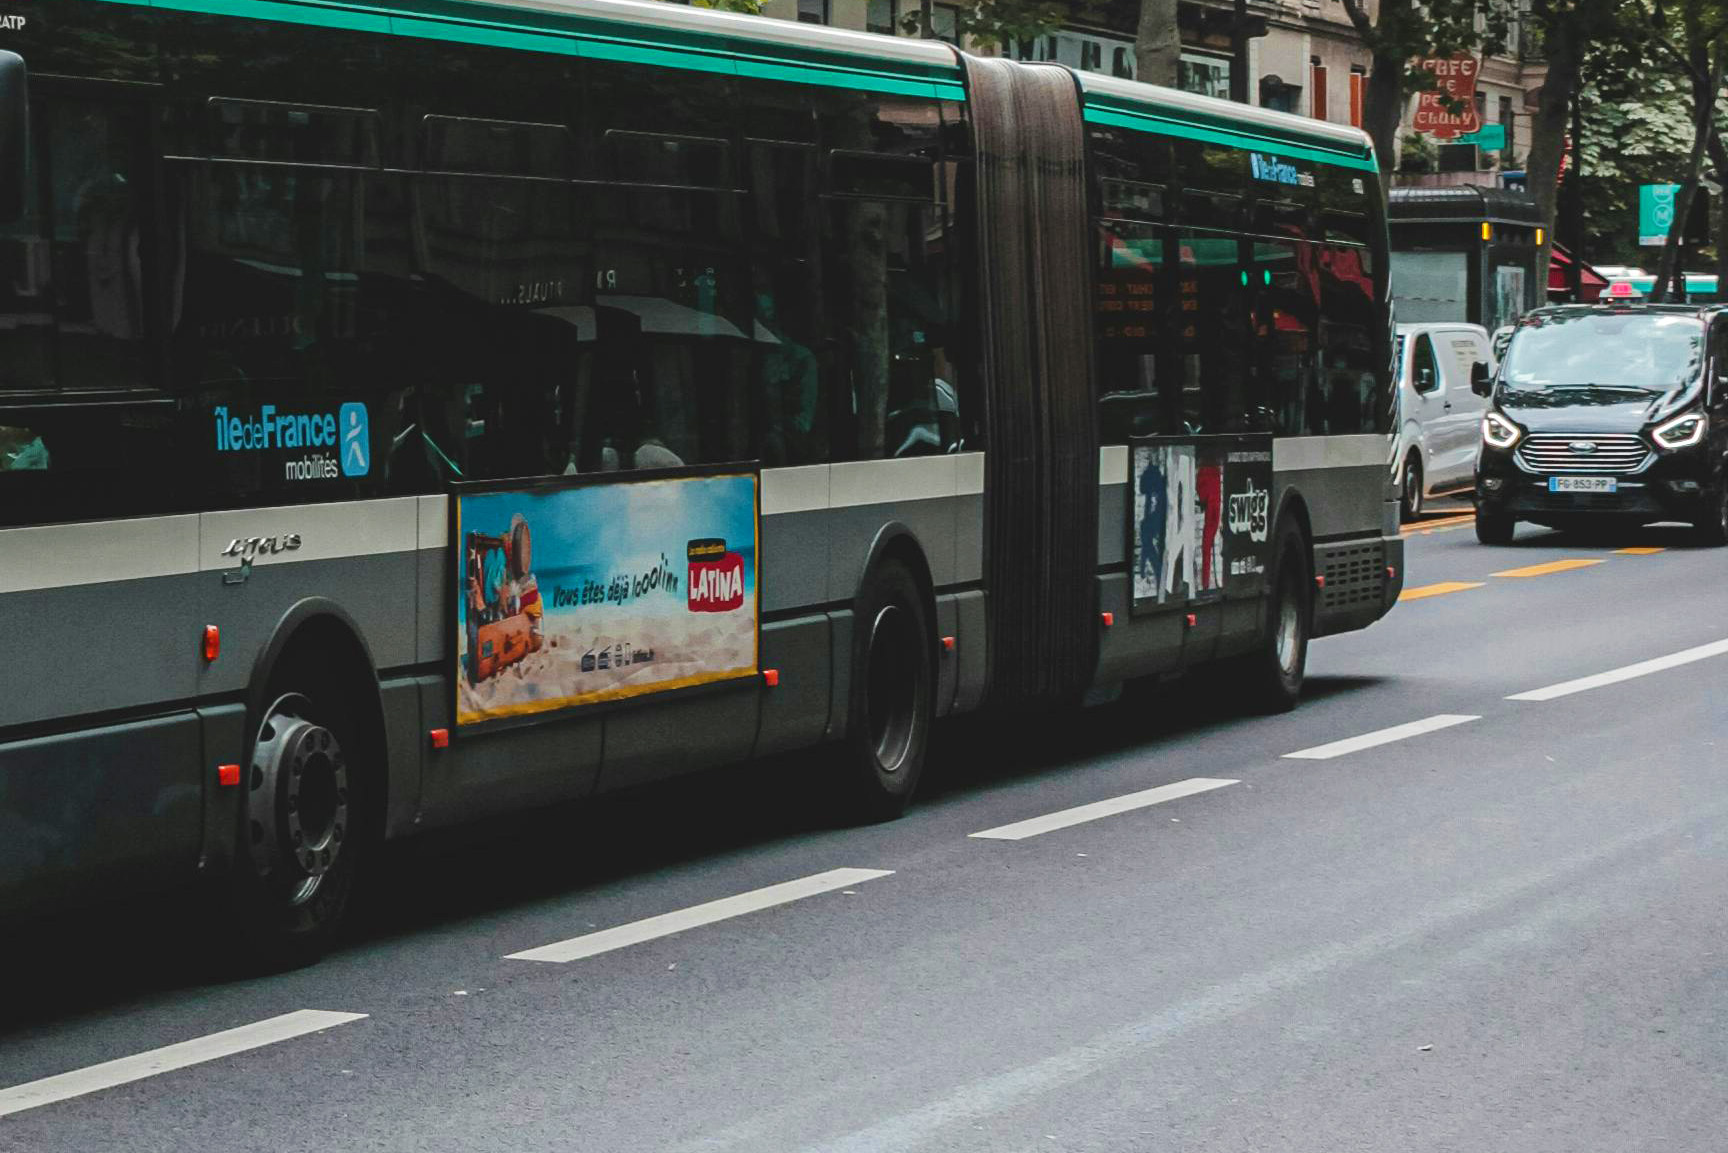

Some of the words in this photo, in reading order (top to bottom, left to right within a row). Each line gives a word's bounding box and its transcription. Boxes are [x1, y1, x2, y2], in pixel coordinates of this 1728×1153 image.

[285, 452, 339, 480] mobilités
[553, 584, 579, 608] Vous
[690, 565, 743, 603] LATINA
